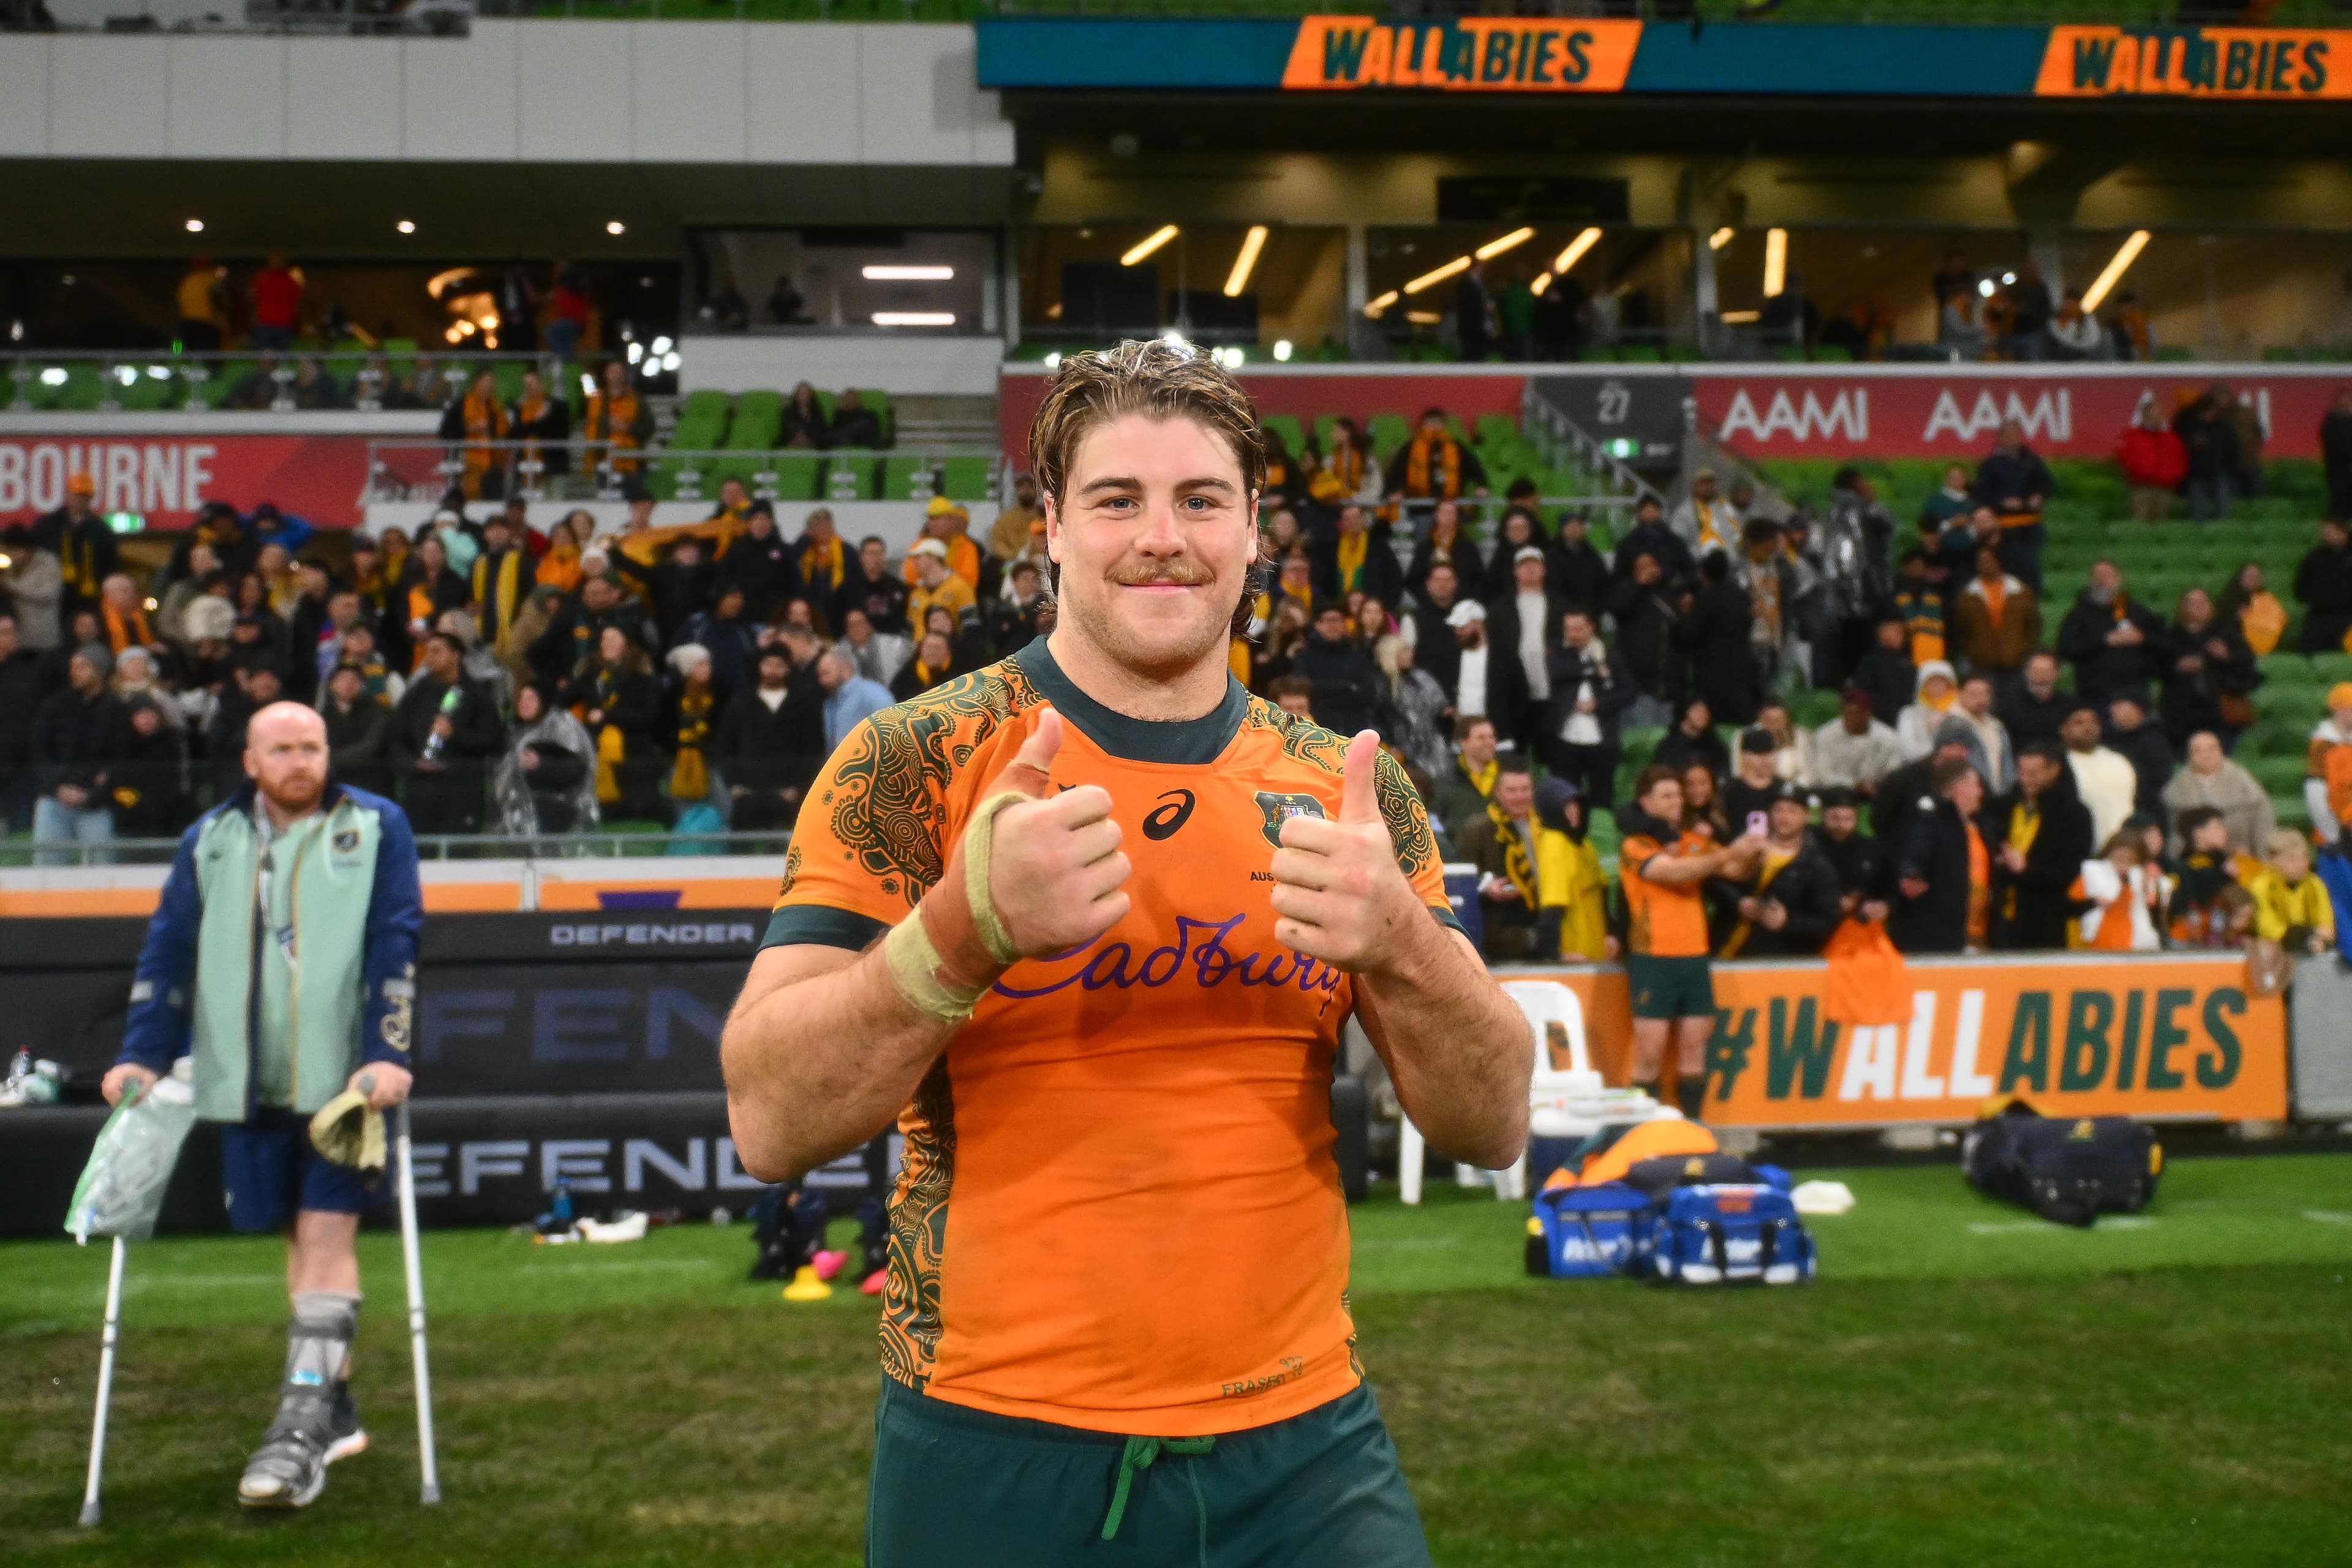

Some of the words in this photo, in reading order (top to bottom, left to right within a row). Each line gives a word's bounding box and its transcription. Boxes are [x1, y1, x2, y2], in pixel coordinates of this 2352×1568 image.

[1322, 26, 1594, 85] WALLABIES
[2071, 34, 2328, 93] WALLABIES
[1718, 387, 1869, 442] AAMI
[1250, 872, 1275, 881] AUS
[552, 924, 754, 944] DEFENDER
[1707, 987, 2247, 1101] #WALLABIES
